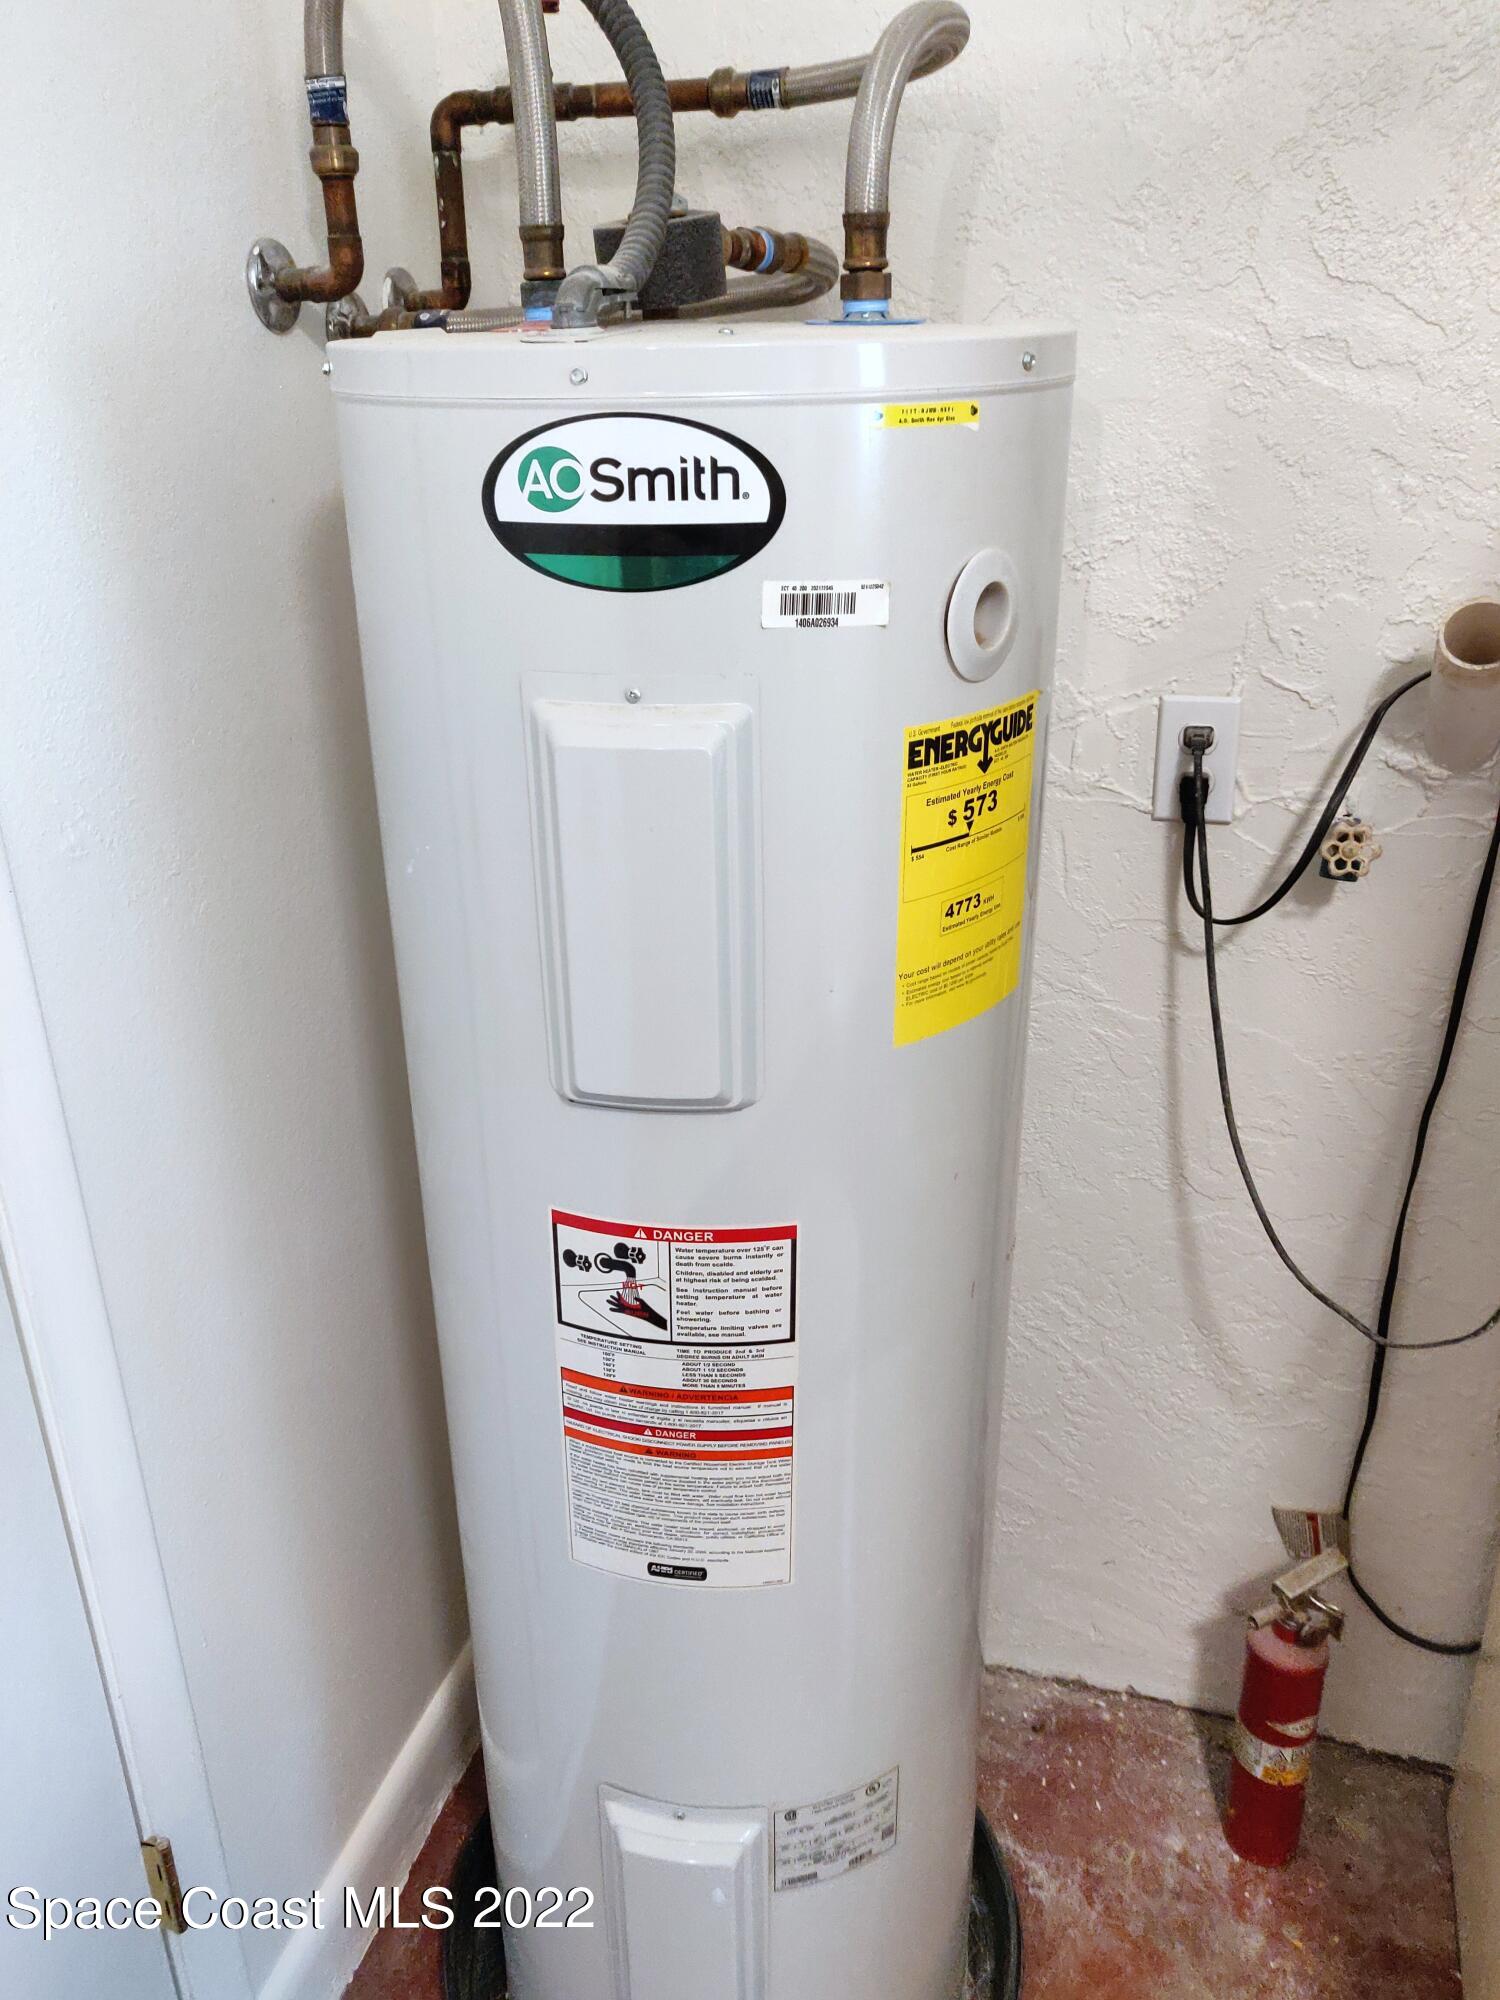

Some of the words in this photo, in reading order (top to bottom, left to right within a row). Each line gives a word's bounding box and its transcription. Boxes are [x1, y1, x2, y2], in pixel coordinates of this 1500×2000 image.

[590, 455, 739, 502] Smith
[795, 618, 839, 627] 1406A026934
[908, 703, 1034, 770] ENERGYGUIDE
[926, 791, 960, 807] Estimated
[963, 784, 981, 797] Yearly
[983, 778, 1001, 790] Energy
[1003, 771, 1014, 781] Cost
[948, 809, 957, 827] $
[963, 790, 998, 821] 573
[945, 893, 981, 918] 4773
[942, 920, 965, 932] Estimated
[899, 970, 914, 980] Your
[916, 967, 930, 976] cost
[931, 963, 941, 971] will
[943, 954, 964, 967] depend
[653, 1230, 714, 1241] DANGER
[580, 1333, 617, 1345] TEMPERATURE
[588, 1340, 622, 1352] INSTRUCTION
[629, 1388, 669, 1398] WARNING
[655, 1429, 696, 1439] DANGER
[656, 1450, 696, 1458] WARNING
